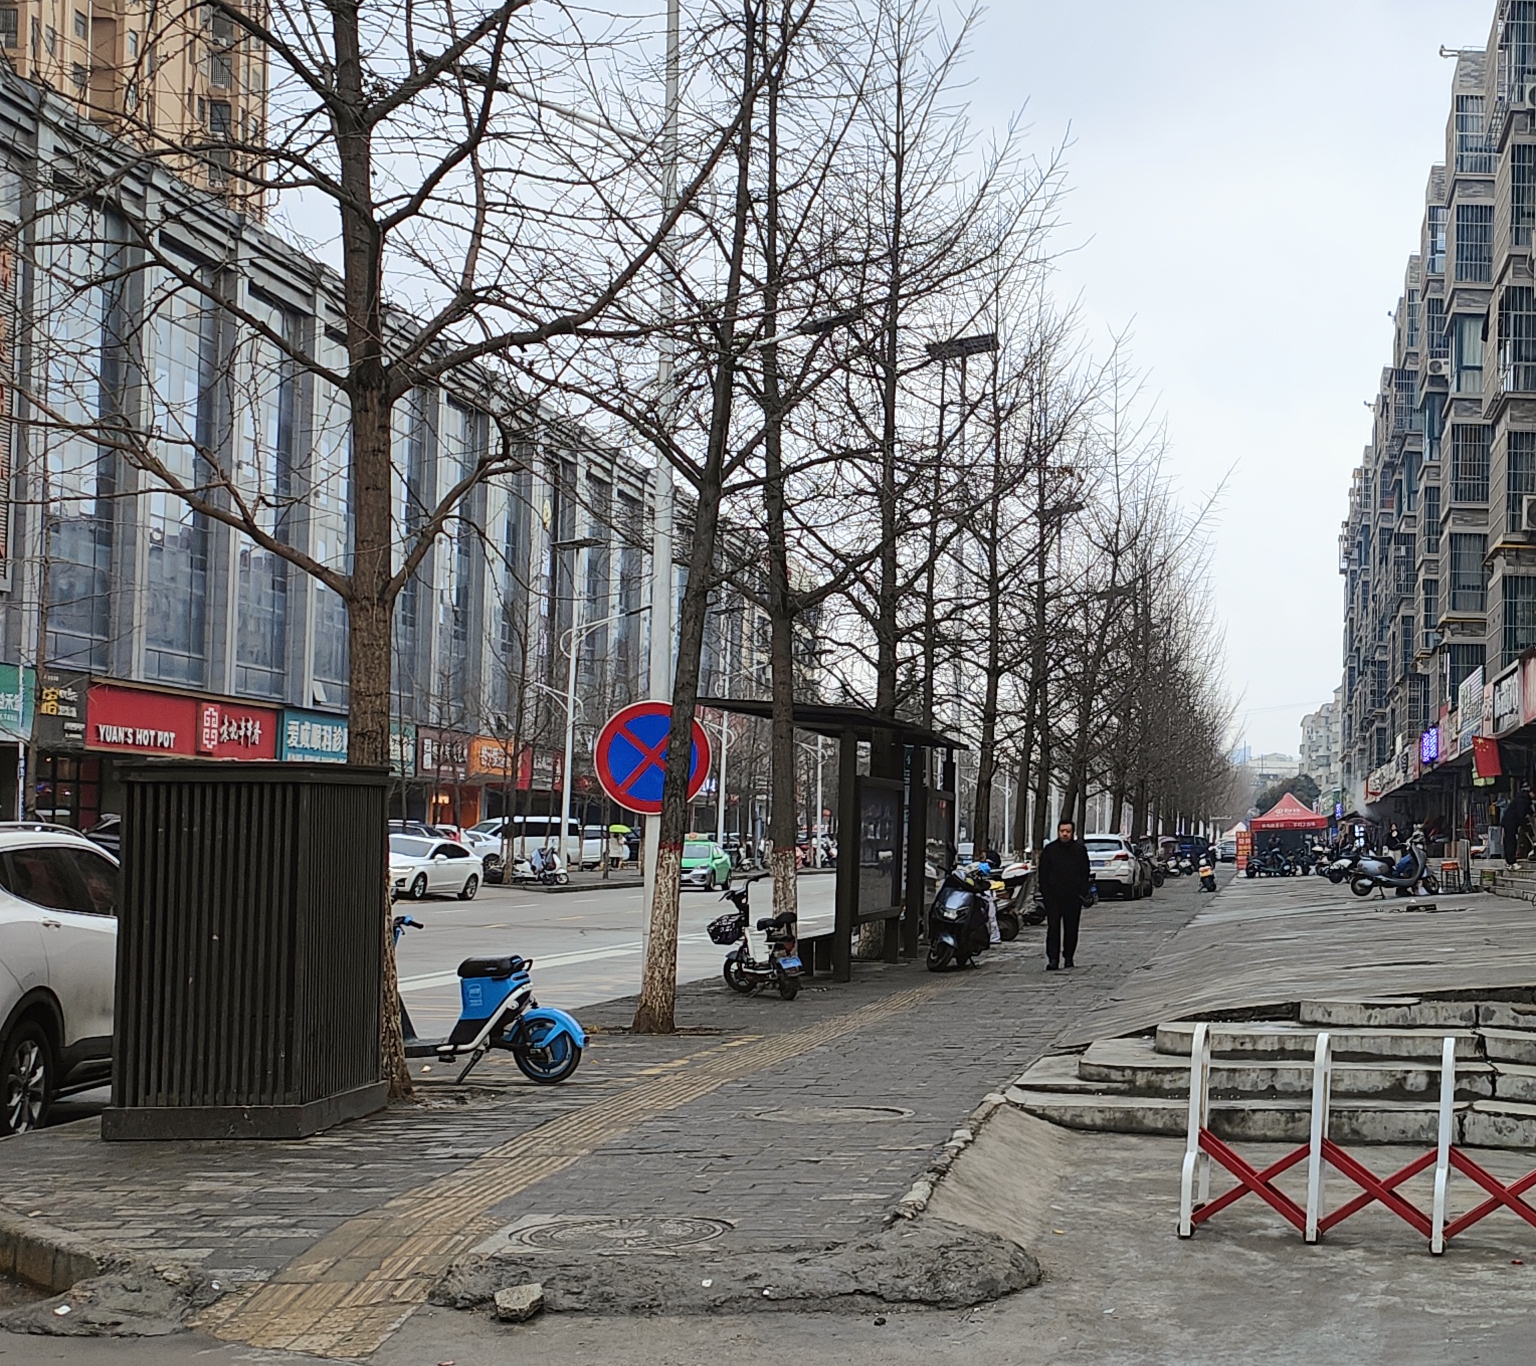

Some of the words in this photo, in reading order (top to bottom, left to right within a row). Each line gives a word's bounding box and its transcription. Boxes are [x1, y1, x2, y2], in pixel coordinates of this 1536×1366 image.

[99, 724, 133, 745] YUAN'S
[135, 728, 155, 746] HOT
[157, 730, 176, 748] POT
